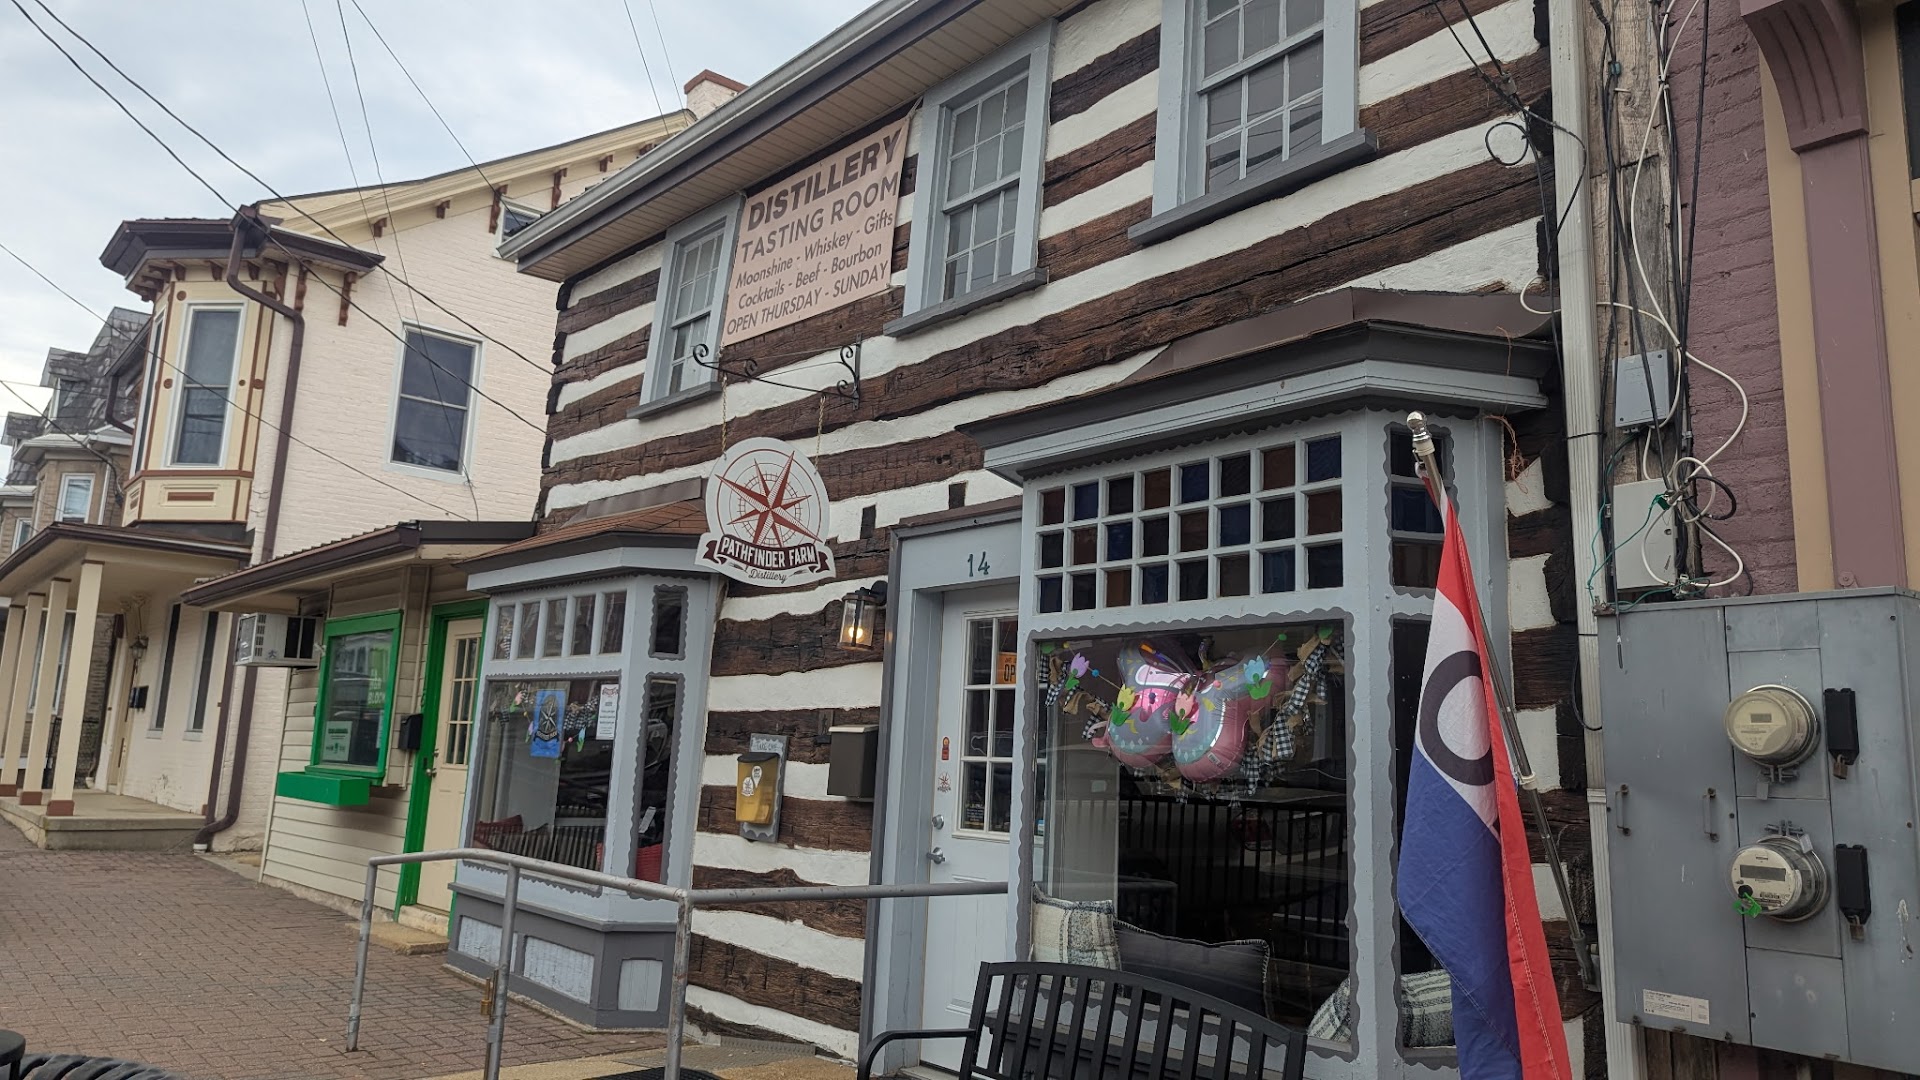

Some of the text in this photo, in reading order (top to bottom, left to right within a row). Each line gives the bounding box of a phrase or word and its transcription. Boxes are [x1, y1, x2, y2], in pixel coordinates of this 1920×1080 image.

[748, 128, 902, 231] DISTILLERY
[735, 257, 793, 289] Moonshine
[804, 230, 853, 261] Whiskey
[864, 209, 893, 235] Gifts
[742, 172, 899, 263] TASTING ROOM
[726, 312, 758, 335] OPEN
[760, 288, 822, 325] THURSDAY
[832, 261, 889, 298] SUNDAY
[738, 279, 784, 310] Cocktails
[795, 262, 821, 289] Beef
[831, 243, 882, 273] Bourbon
[721, 537, 816, 568] PATHFINDER FARM
[748, 569, 788, 584] Distillery
[967, 551, 990, 577] 14
